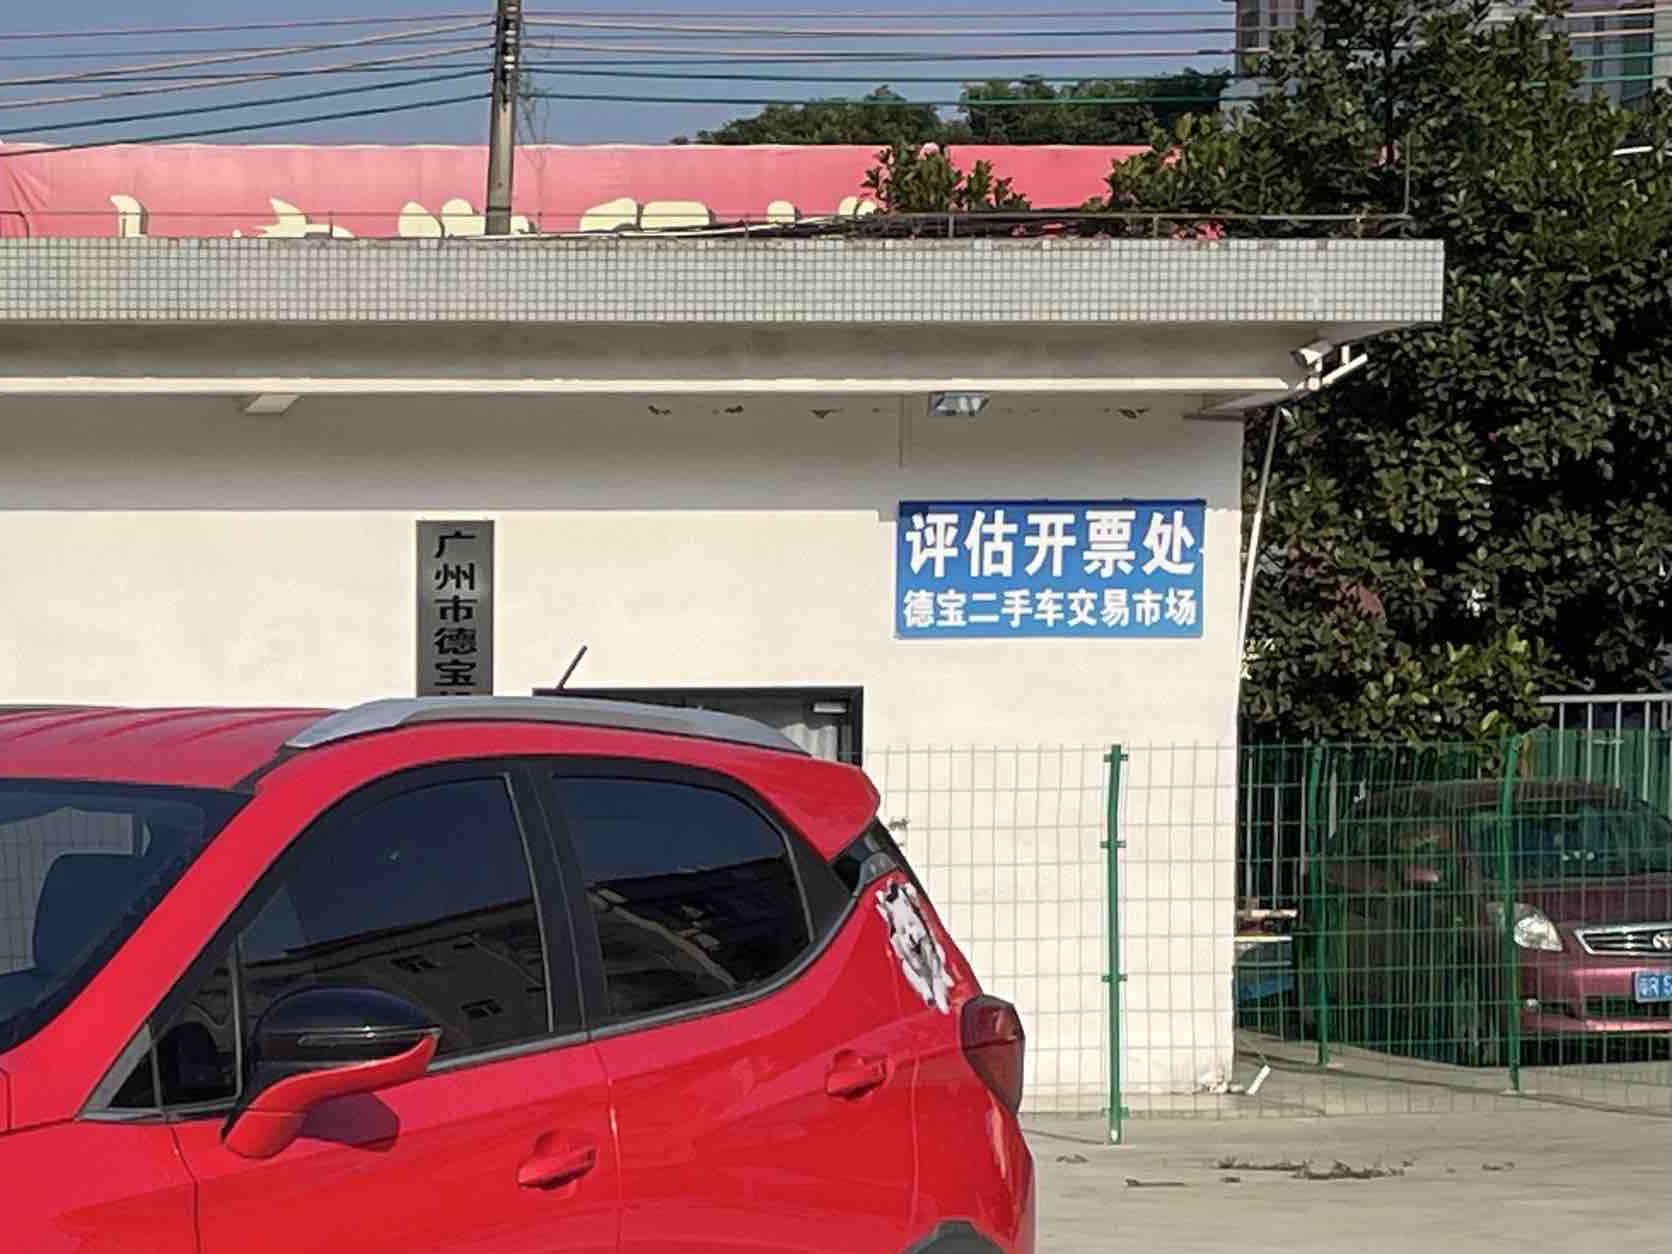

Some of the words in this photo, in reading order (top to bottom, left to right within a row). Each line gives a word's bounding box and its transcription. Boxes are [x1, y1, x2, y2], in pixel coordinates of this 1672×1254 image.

[905, 509, 1195, 578] 评估开票处
[433, 530, 478, 696] 广州市德宝
[903, 588, 1196, 628] 德宝二手车交易市场
